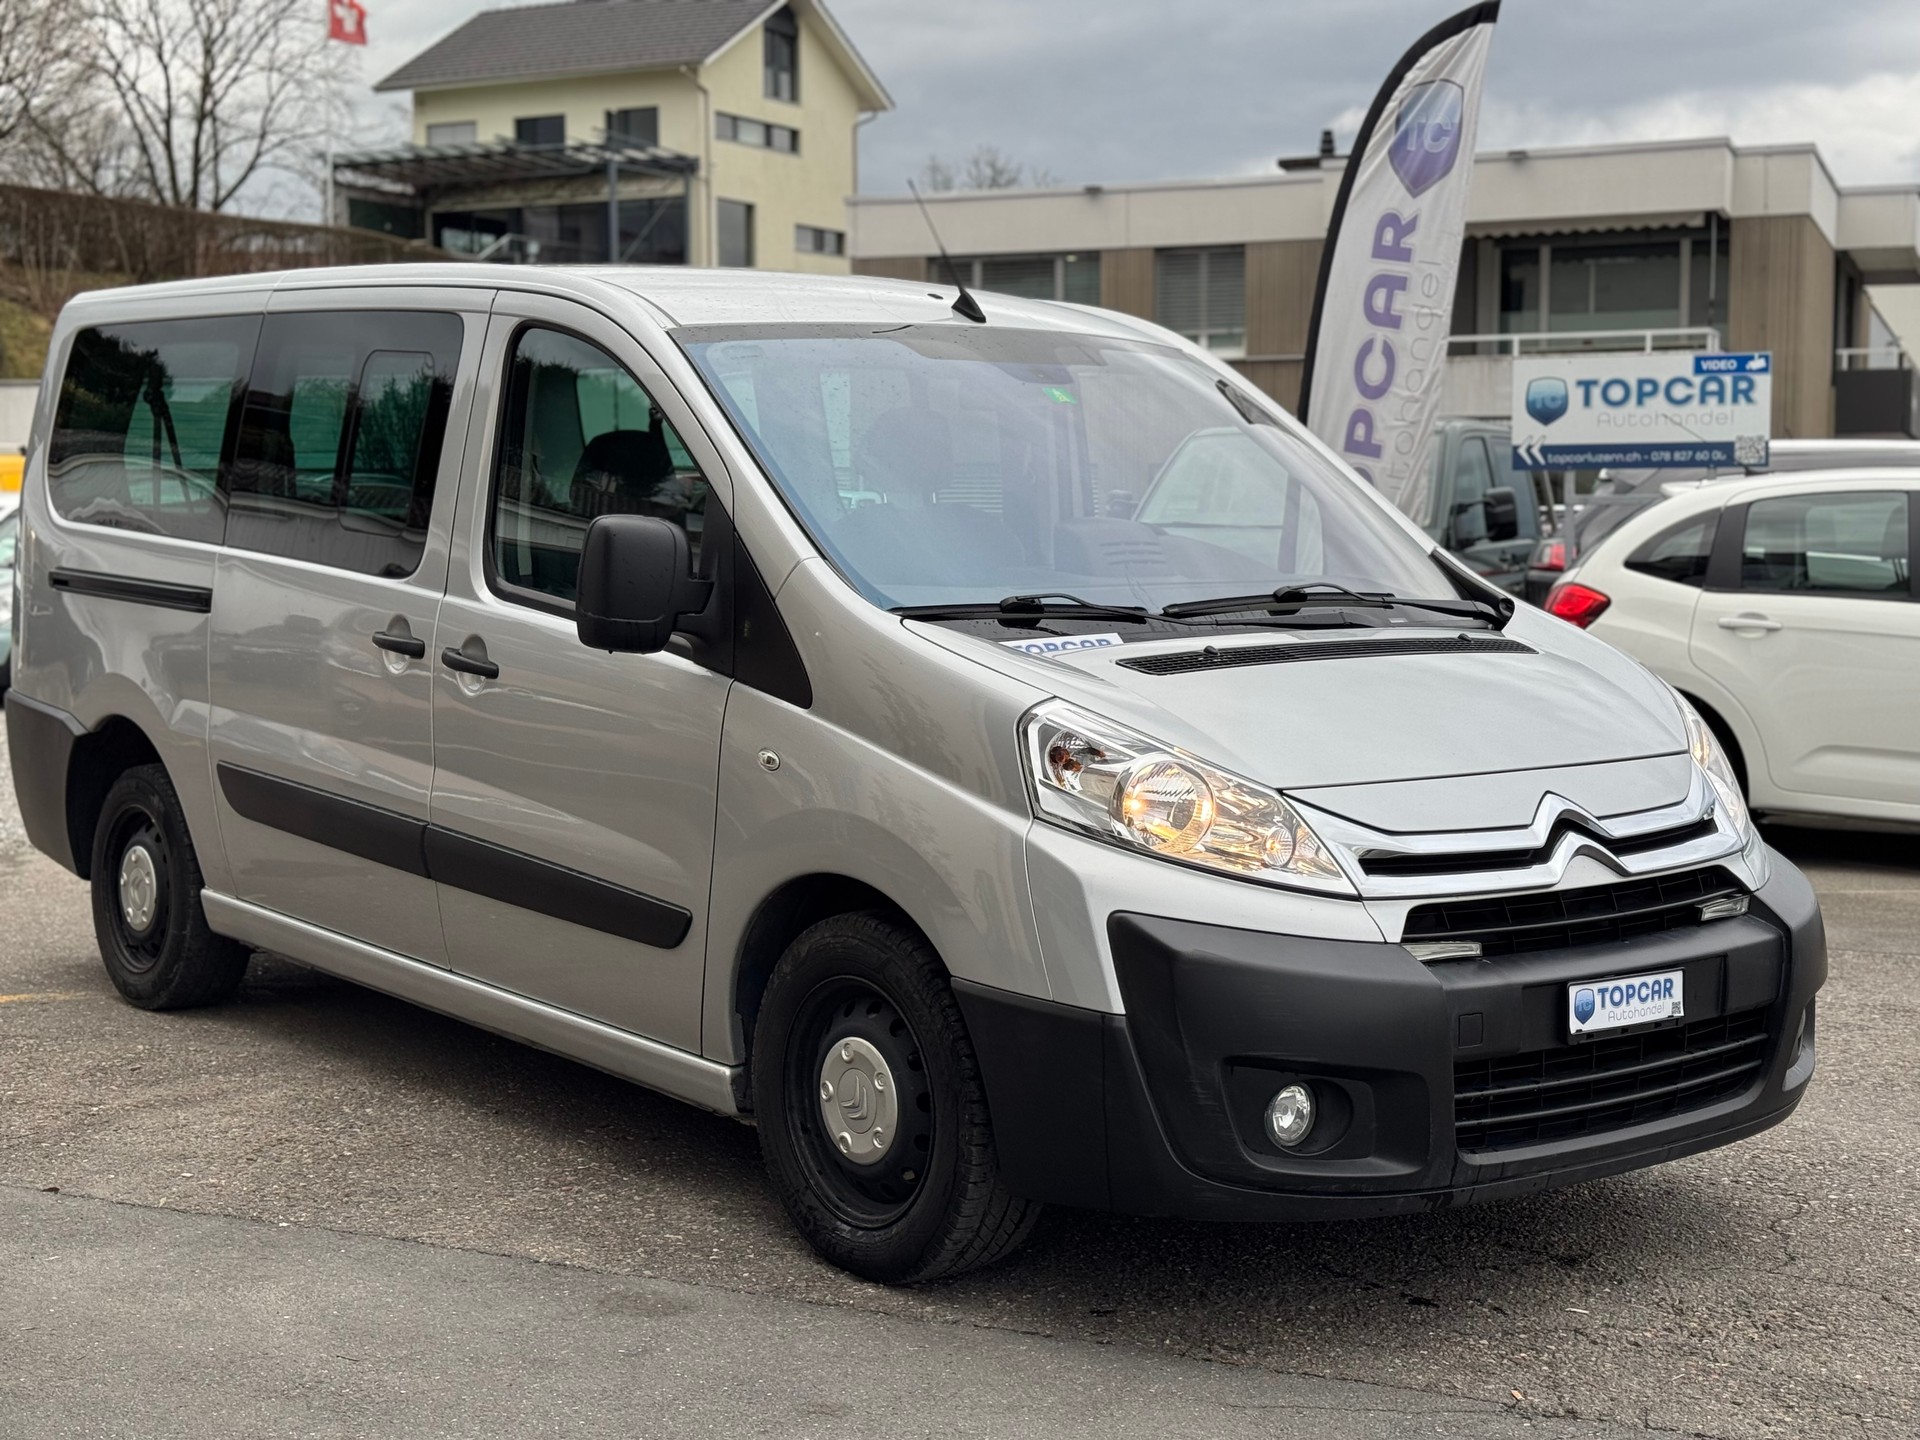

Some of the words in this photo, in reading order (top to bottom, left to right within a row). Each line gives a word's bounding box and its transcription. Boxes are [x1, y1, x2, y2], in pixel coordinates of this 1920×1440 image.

[1344, 211, 1419, 487] PCAR
[1700, 359, 1737, 371] VIDEO
[1576, 375, 1756, 408] TOPCAR
[1597, 411, 1734, 428] Autohandel
[1012, 639, 1111, 654] OPCAR
[1598, 978, 1674, 1009] TOPCAR
[1608, 1002, 1665, 1022] Autohandel
